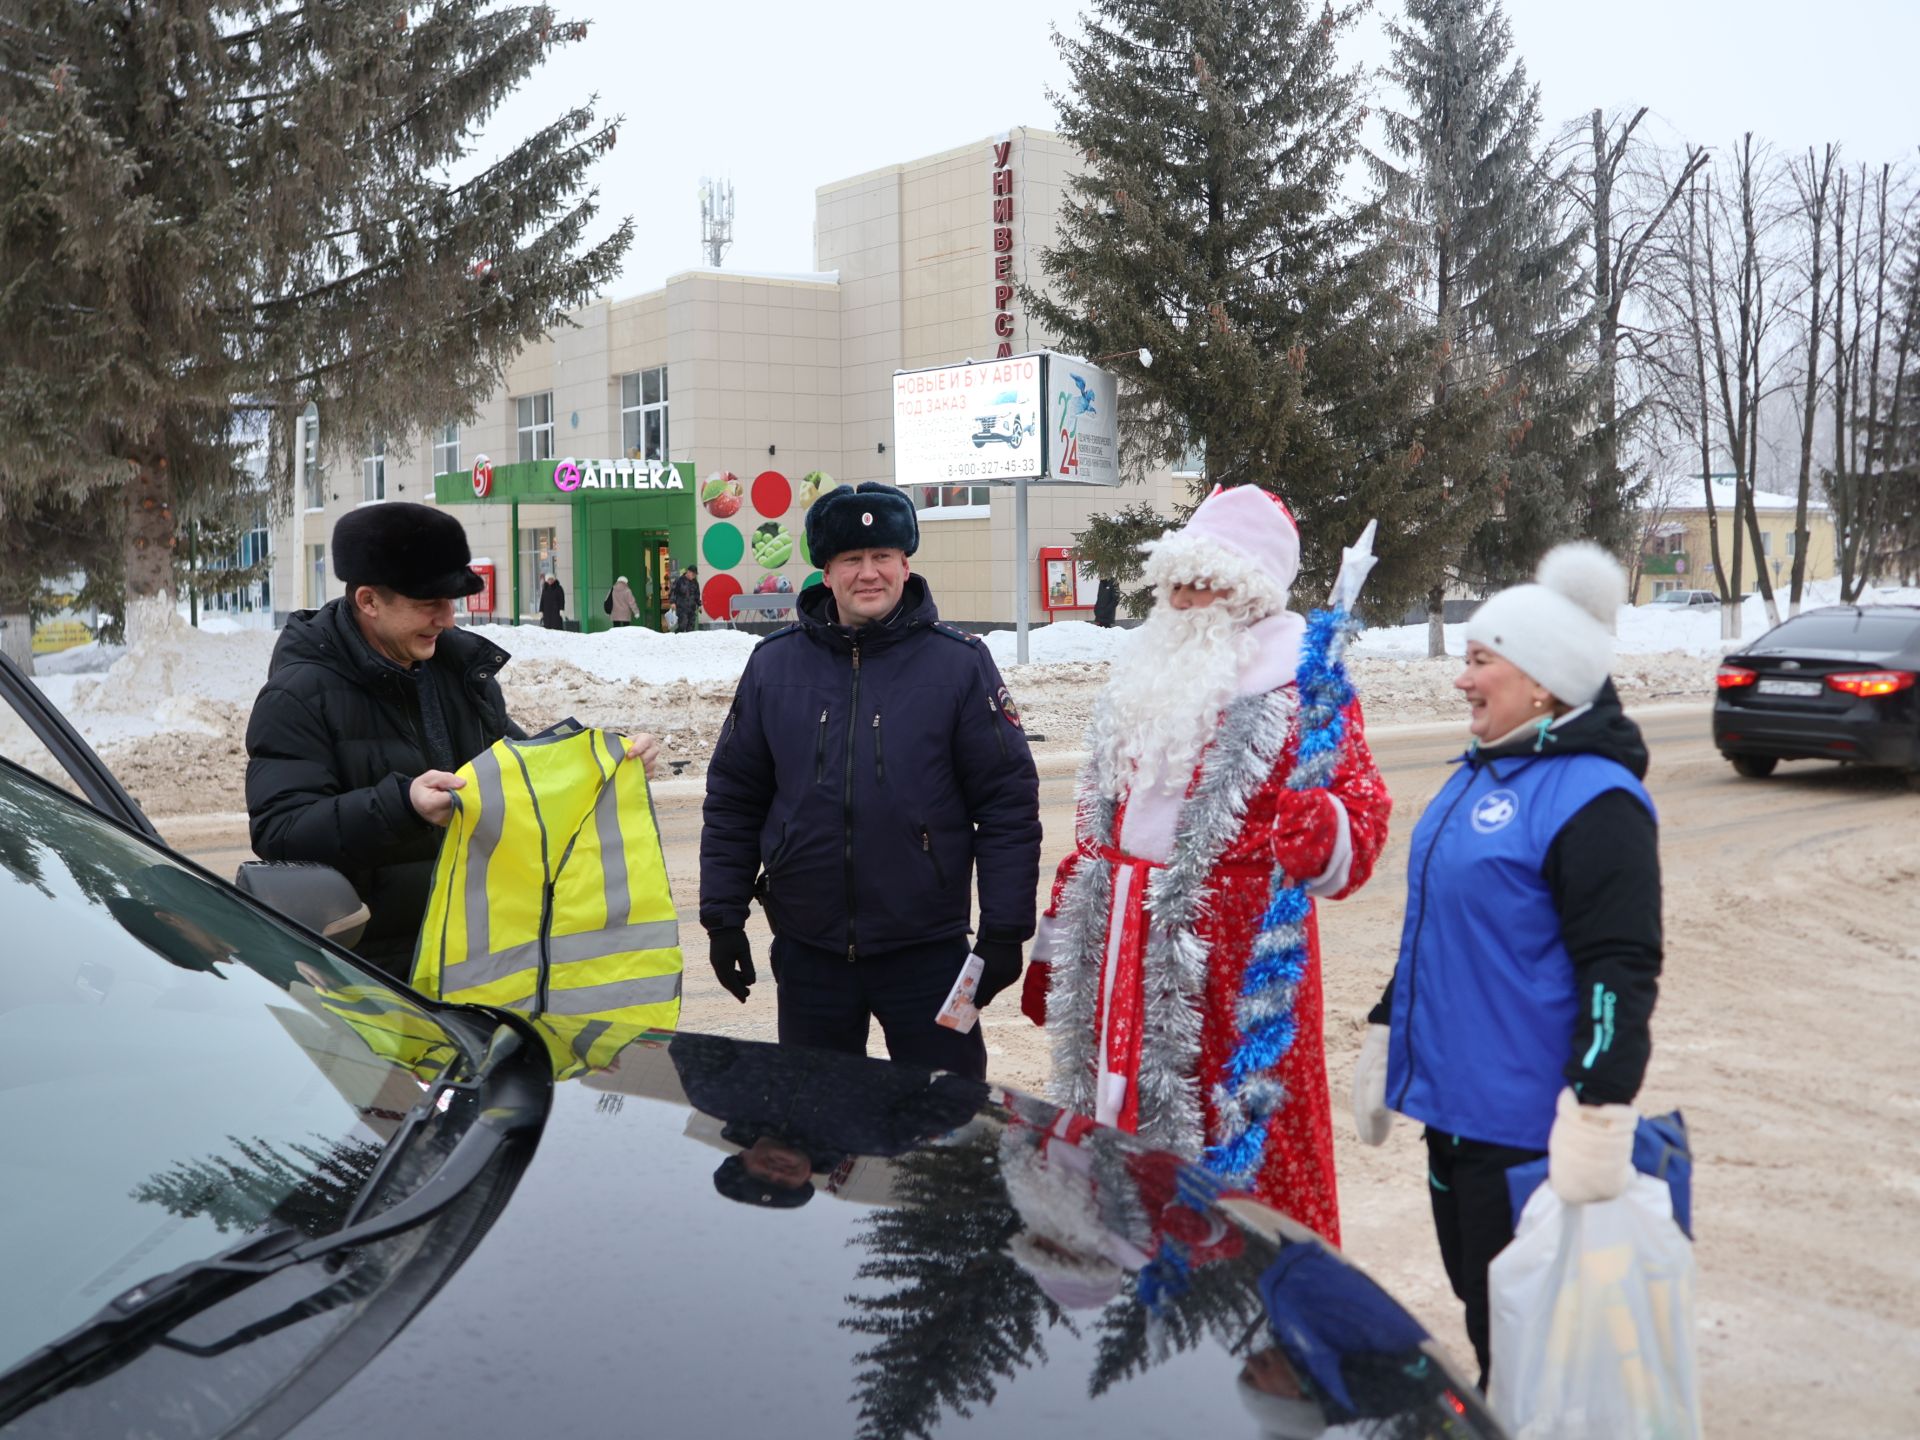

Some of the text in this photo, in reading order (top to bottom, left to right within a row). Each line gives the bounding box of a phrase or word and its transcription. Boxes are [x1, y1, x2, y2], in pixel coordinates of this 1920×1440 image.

[897, 373, 946, 395] НОВЫЕ
[950, 371, 960, 389] И
[992, 361, 1033, 384] АВТО
[897, 394, 967, 416] ПОД ЗАКАЗ
[581, 467, 684, 489] АПТЕКА
[948, 458, 1035, 477] 8-900-327-45-33
